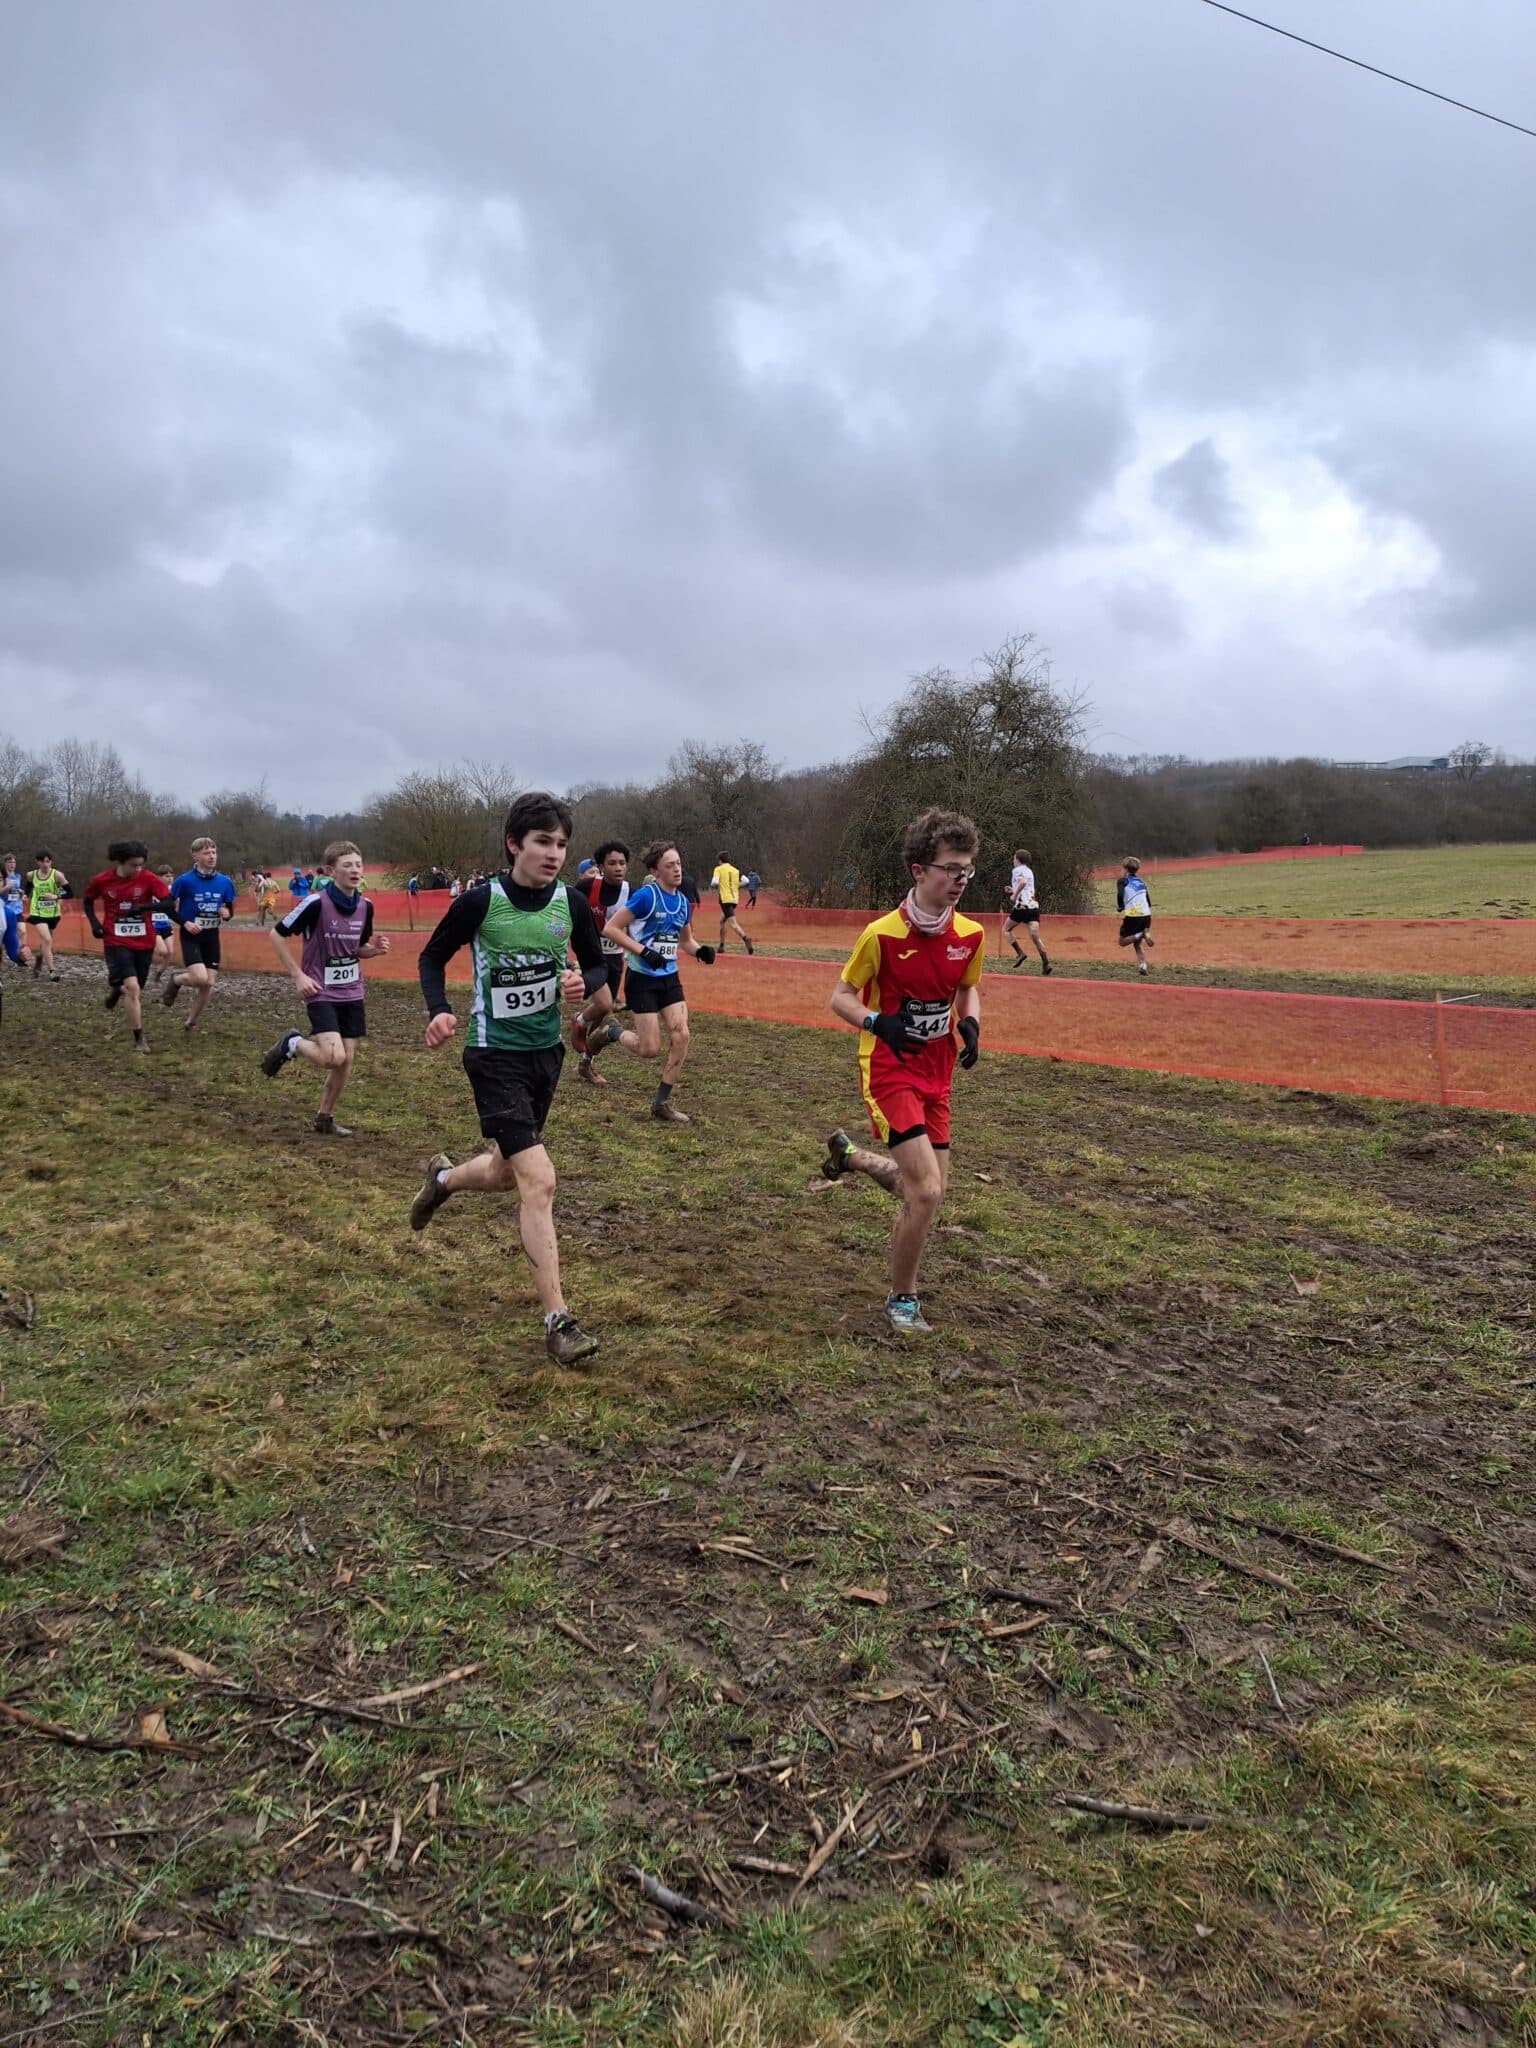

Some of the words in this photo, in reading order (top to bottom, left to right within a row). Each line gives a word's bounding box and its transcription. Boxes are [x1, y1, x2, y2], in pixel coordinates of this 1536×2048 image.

[120, 925, 141, 934] 675
[332, 967, 354, 980] 201
[501, 974, 514, 982] TDR
[505, 986, 546, 1010] 931
